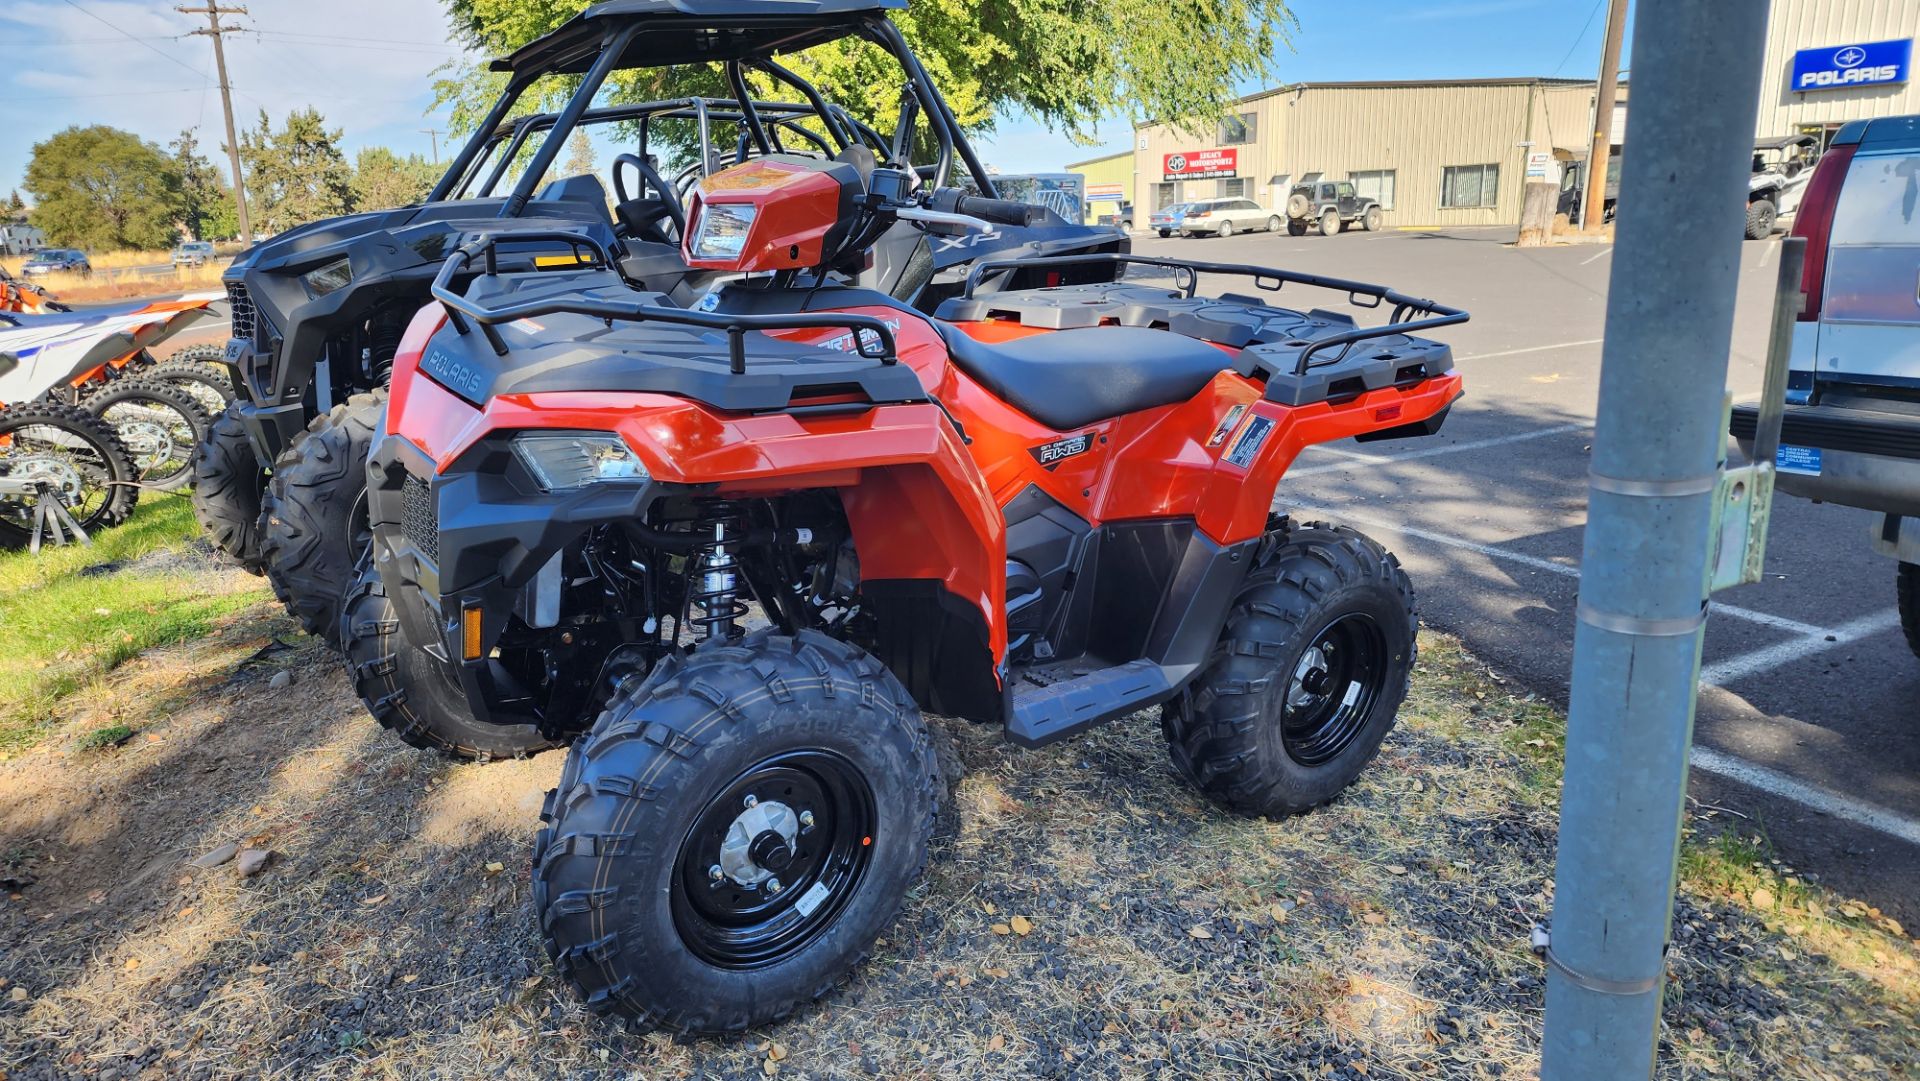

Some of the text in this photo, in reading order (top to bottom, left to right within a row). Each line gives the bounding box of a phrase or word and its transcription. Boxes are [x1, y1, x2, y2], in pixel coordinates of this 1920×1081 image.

[1801, 65, 1896, 87] POLARIS
[1189, 158, 1232, 167] MOTORSPORTZ
[1200, 151, 1221, 159] LEGACY
[935, 231, 1002, 253] XP
[428, 350, 481, 393] POLARIS
[1040, 441, 1086, 463] AWD
